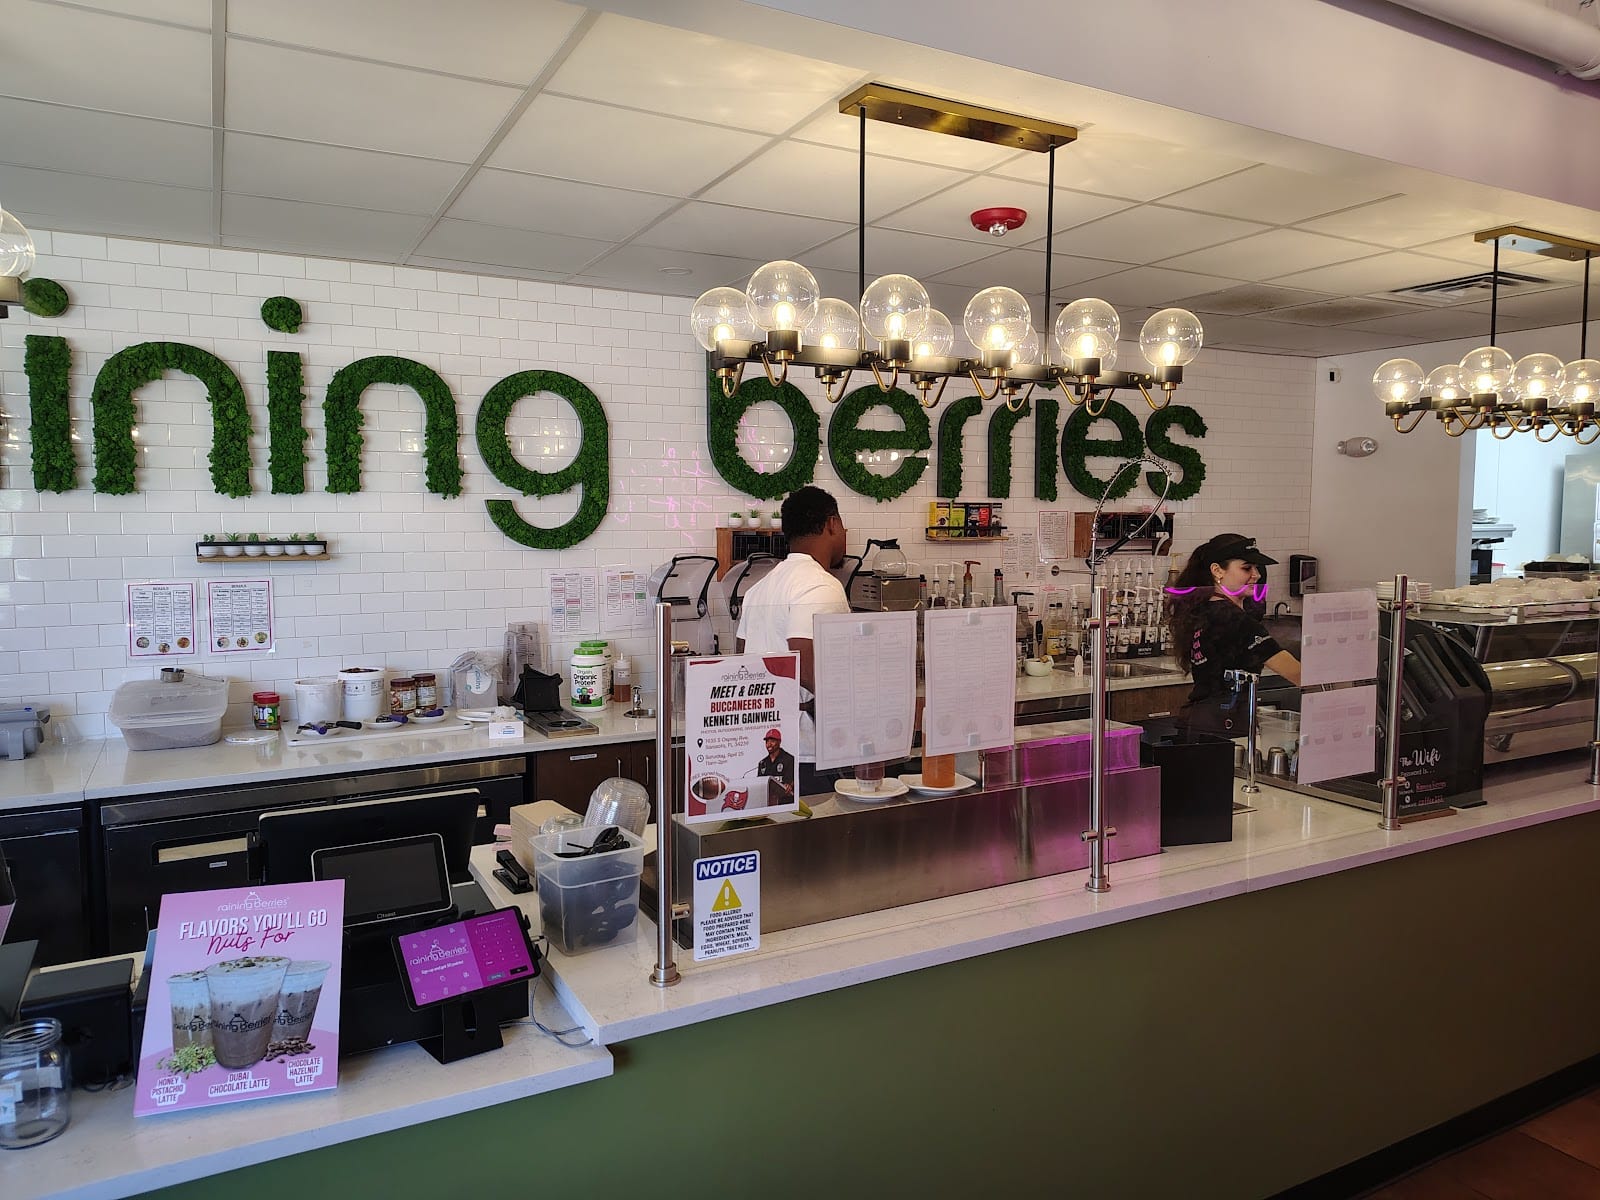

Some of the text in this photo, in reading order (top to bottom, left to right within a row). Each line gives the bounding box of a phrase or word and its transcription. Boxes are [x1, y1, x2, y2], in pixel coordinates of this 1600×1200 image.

[0, 276, 610, 550] ining
[706, 352, 1208, 501] berries
[573, 673, 597, 681] Organic
[710, 682, 776, 699] MEET & GREET
[710, 697, 775, 713] BUCCANEERS RB
[703, 710, 781, 728] KENNETH GAINWELL
[1400, 748, 1441, 768] The Wifi
[699, 856, 756, 878] NOTICE
[217, 900, 253, 911] raining
[723, 908, 742, 916] ALLERGY
[179, 908, 328, 940] FLAVORS YOU'LL GO
[716, 921, 739, 929] PREPARED
[715, 927, 735, 935] CONTAIN
[207, 928, 295, 955] Nuts For
[409, 952, 438, 966] raining
[288, 1057, 321, 1068] CHOCOLATE
[229, 1071, 250, 1082] DUBAI
[289, 1066, 319, 1076] HAZELNUT
[158, 1077, 178, 1087] HONEY
[296, 1075, 313, 1083] LATTE
[151, 1084, 184, 1095] PISTACHIO
[209, 1078, 269, 1094] CHOCOLATE LATTE
[158, 1093, 177, 1103] LATTE
